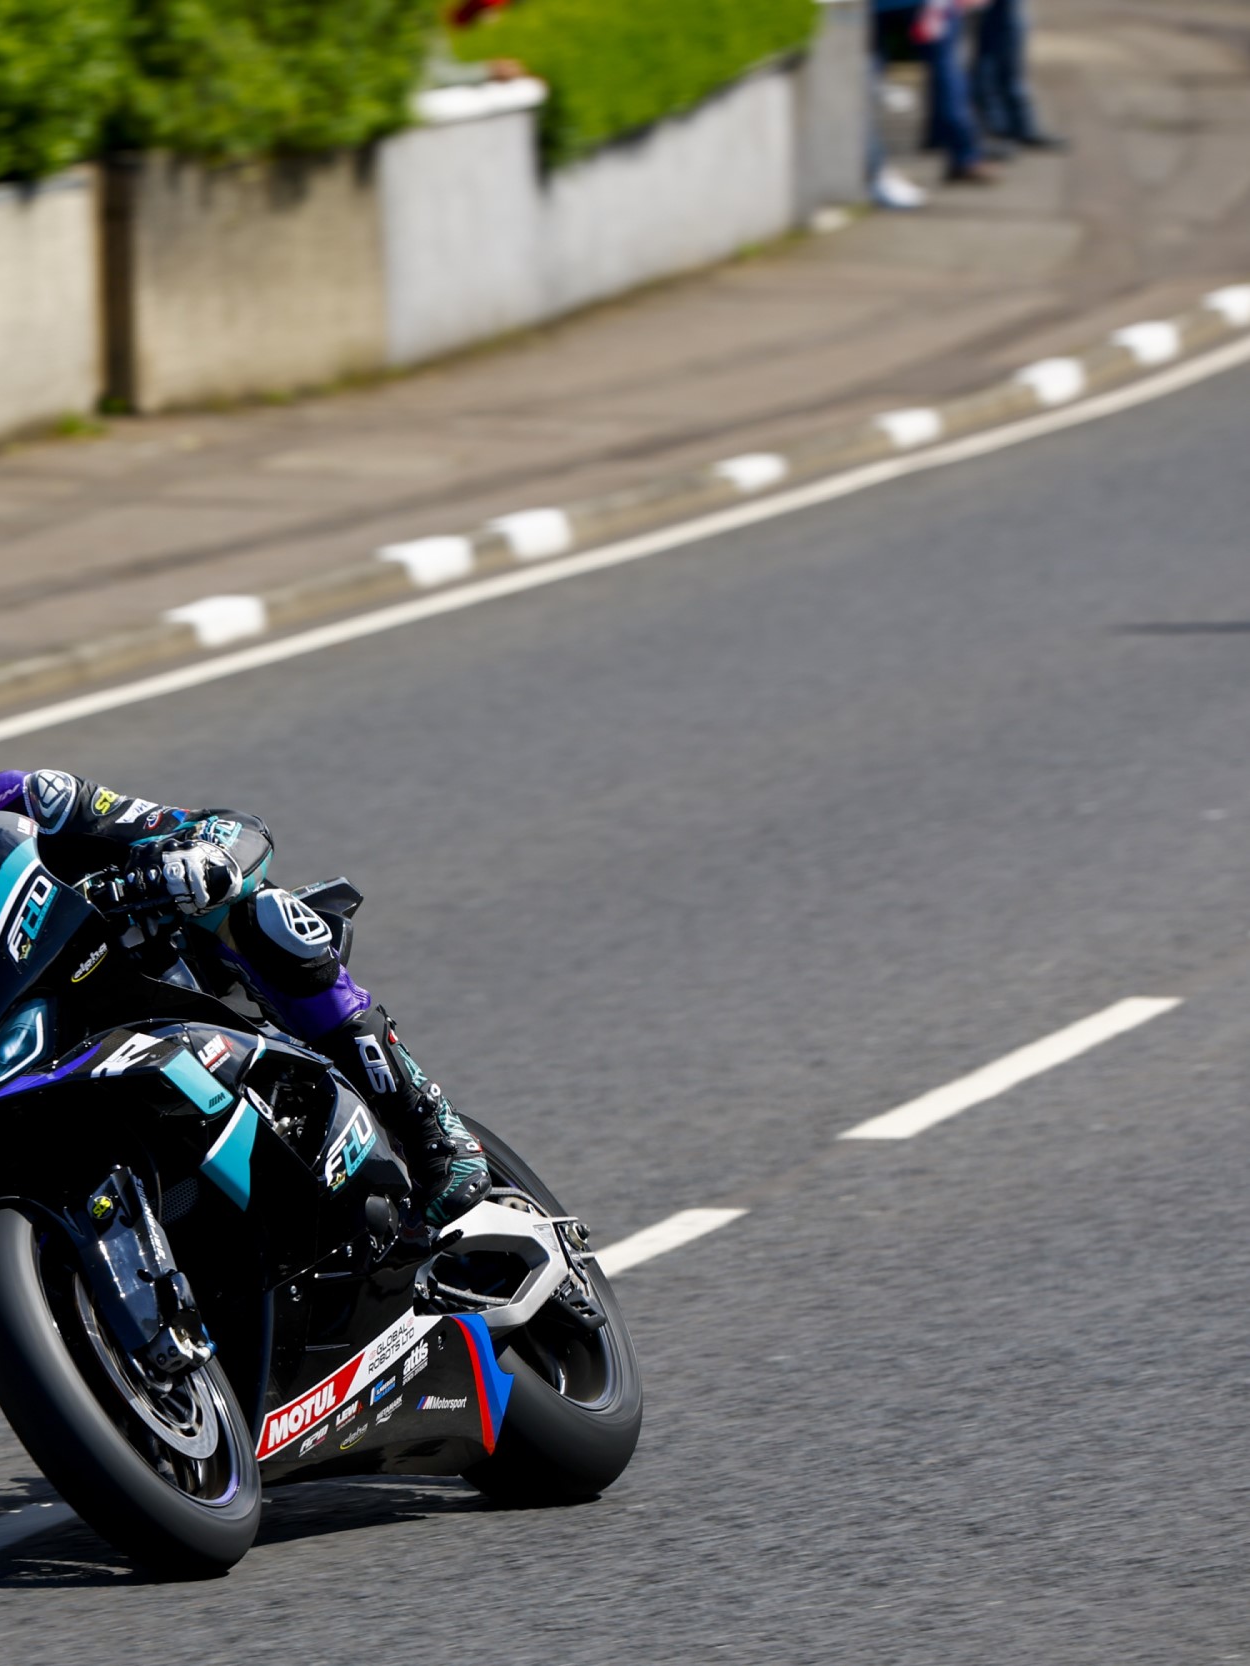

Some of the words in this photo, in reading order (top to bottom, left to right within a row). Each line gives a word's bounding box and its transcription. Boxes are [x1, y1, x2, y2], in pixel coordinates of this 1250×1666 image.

[324, 1104, 373, 1187] FHO
[368, 1340, 401, 1374] ROBOTS
[401, 1327, 414, 1347] LTD
[376, 1323, 408, 1356] GLOBAL
[267, 1381, 337, 1450] MOTUL
[335, 1400, 359, 1427] LEW
